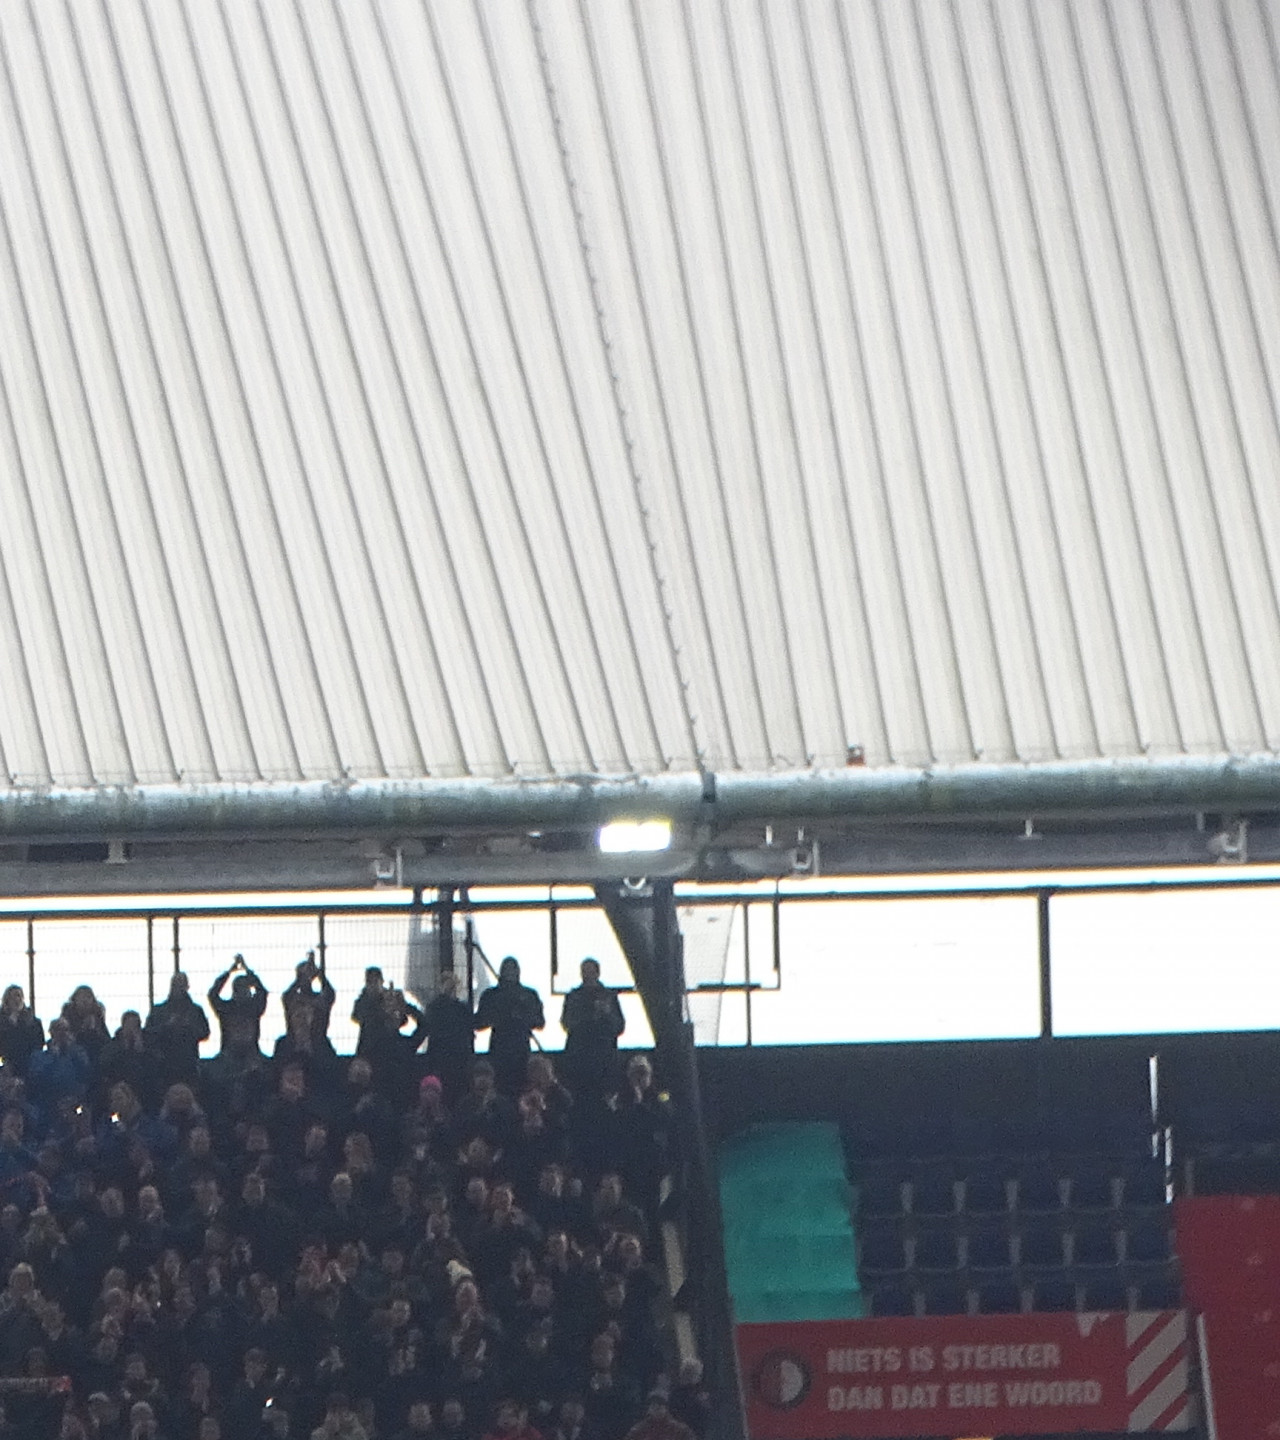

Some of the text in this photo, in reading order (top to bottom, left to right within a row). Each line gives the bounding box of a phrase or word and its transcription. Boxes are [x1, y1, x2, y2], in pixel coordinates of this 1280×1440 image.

[827, 1344, 1061, 1373] NIETS IS STERKER
[827, 1386, 884, 1411] DAN
[890, 1384, 942, 1409] DAT
[1005, 1379, 1102, 1405] WOORD
